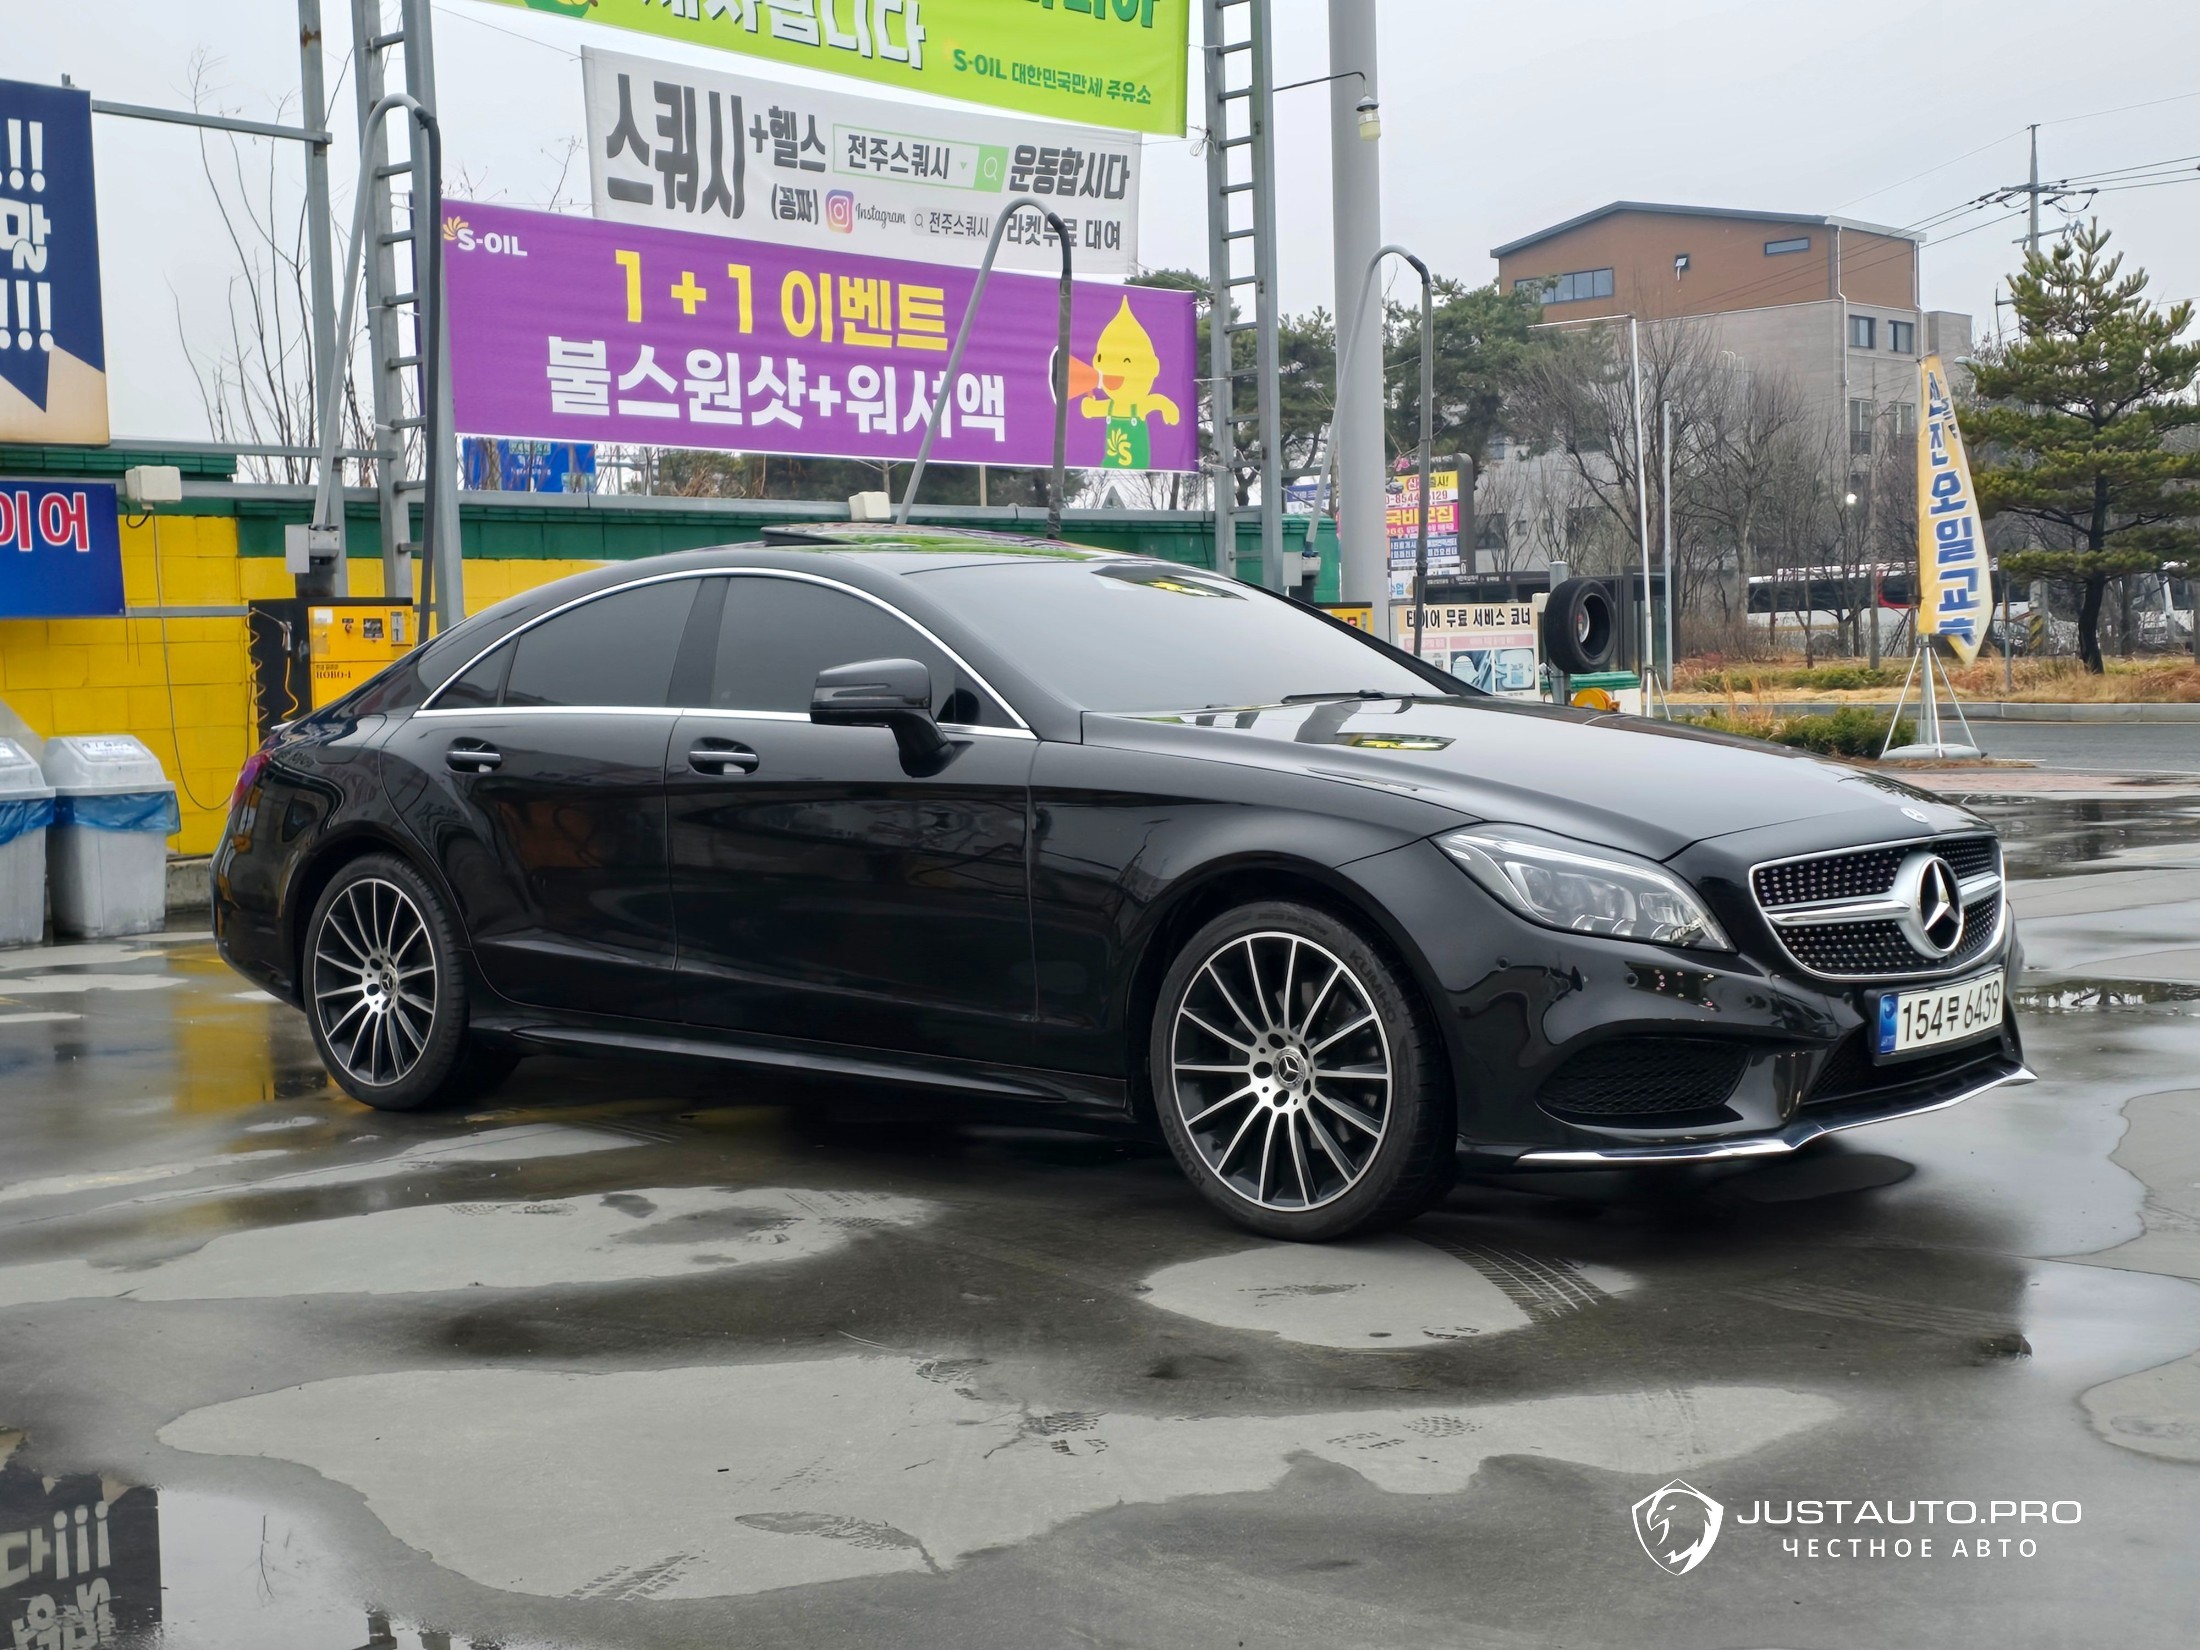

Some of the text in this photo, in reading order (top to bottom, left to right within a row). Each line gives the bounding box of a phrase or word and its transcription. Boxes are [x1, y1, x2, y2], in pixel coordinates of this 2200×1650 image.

[1011, 62, 1102, 98] 대한민국만세
[1106, 79, 1152, 105] 주유소
[848, 133, 950, 180] 전주스쿼시
[1009, 144, 1130, 200] 운동합시다
[855, 202, 906, 230] Instagram
[929, 211, 989, 238] 전주스쿼시
[457, 228, 528, 257] S-OIL
[1085, 220, 1121, 250] 대여
[781, 269, 948, 351] 이벤트
[1446, 609, 1468, 628] 무료
[1473, 608, 1506, 627] 서비스
[1511, 607, 1531, 626] 코너
